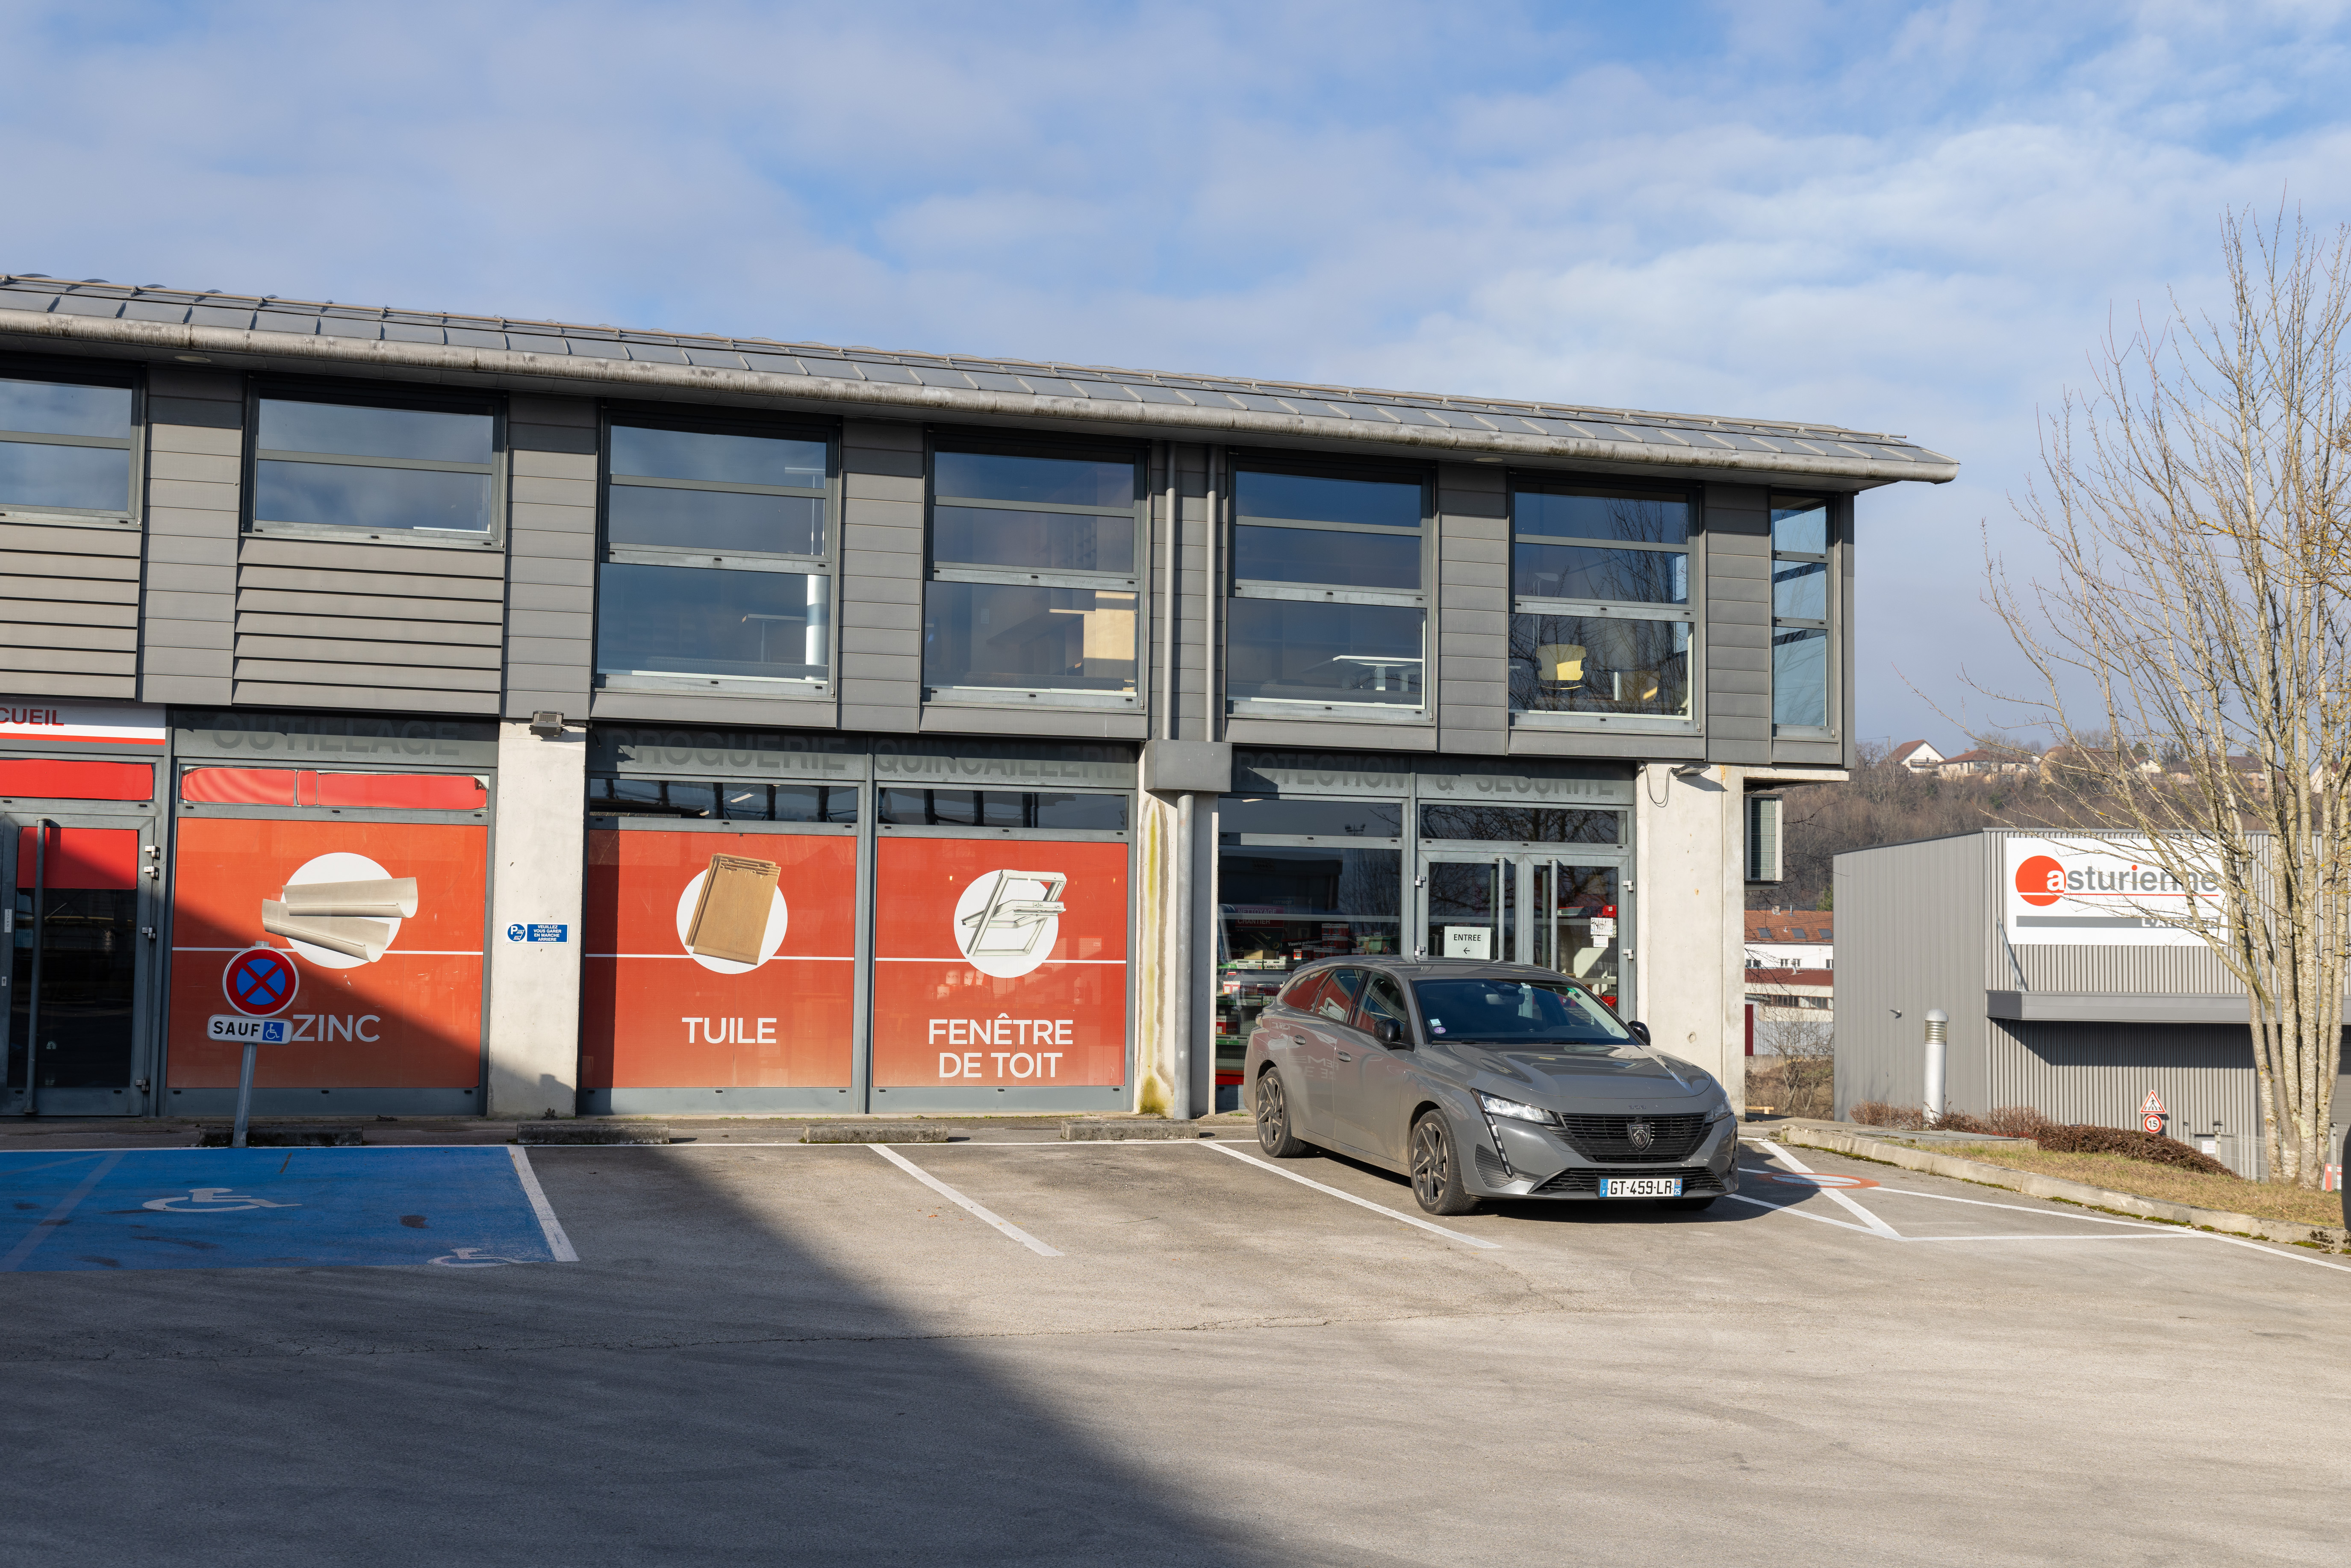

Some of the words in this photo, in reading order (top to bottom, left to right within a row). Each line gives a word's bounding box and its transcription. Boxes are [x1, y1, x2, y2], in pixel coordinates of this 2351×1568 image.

[212, 713, 460, 756] OUTILLAGE
[606, 729, 846, 771] DROGUERIE
[875, 739, 1129, 779] QUINCAILLERIE
[1232, 751, 1404, 788] ROTECTION
[1436, 760, 1455, 791] &
[2047, 864, 2218, 892] asturienne
[213, 1021, 260, 1037] SAUF
[292, 1014, 381, 1042] ZINC
[682, 1017, 777, 1044] TUILE
[929, 1013, 1073, 1045] FENÊTRE
[939, 1052, 982, 1078] DE
[990, 1052, 1063, 1078] TOIT
[1610, 1180, 1672, 1195] GT-459-LR
